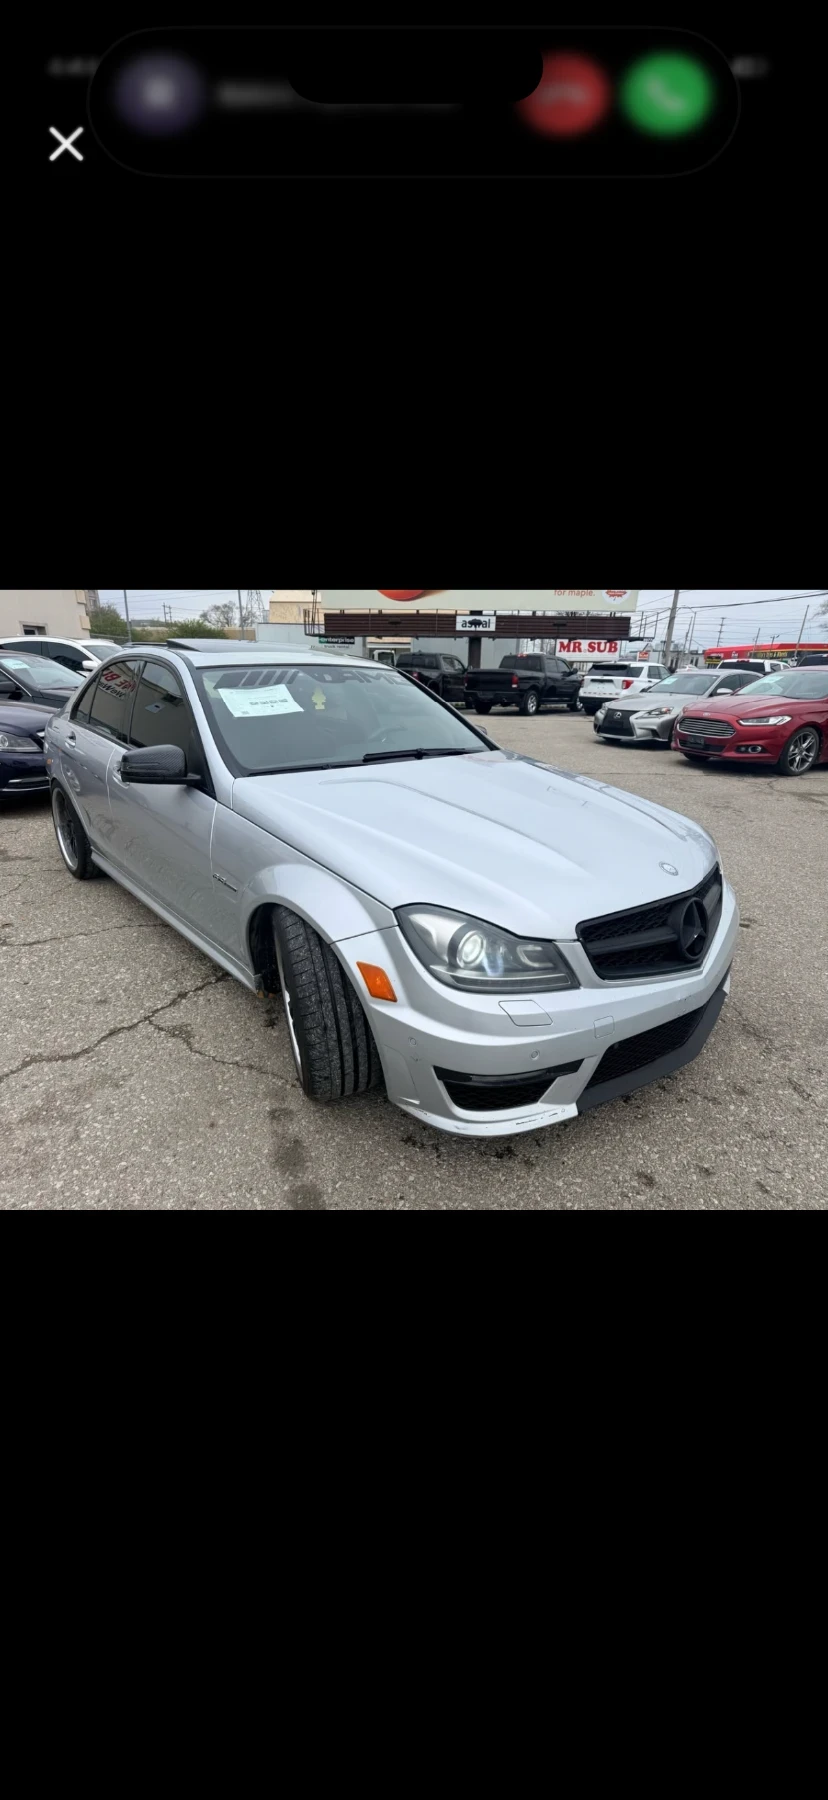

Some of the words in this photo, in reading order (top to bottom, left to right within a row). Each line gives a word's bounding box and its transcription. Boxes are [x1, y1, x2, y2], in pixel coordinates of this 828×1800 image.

[461, 618, 491, 628] asal
[559, 641, 582, 653] MR
[587, 641, 618, 653] SUB
